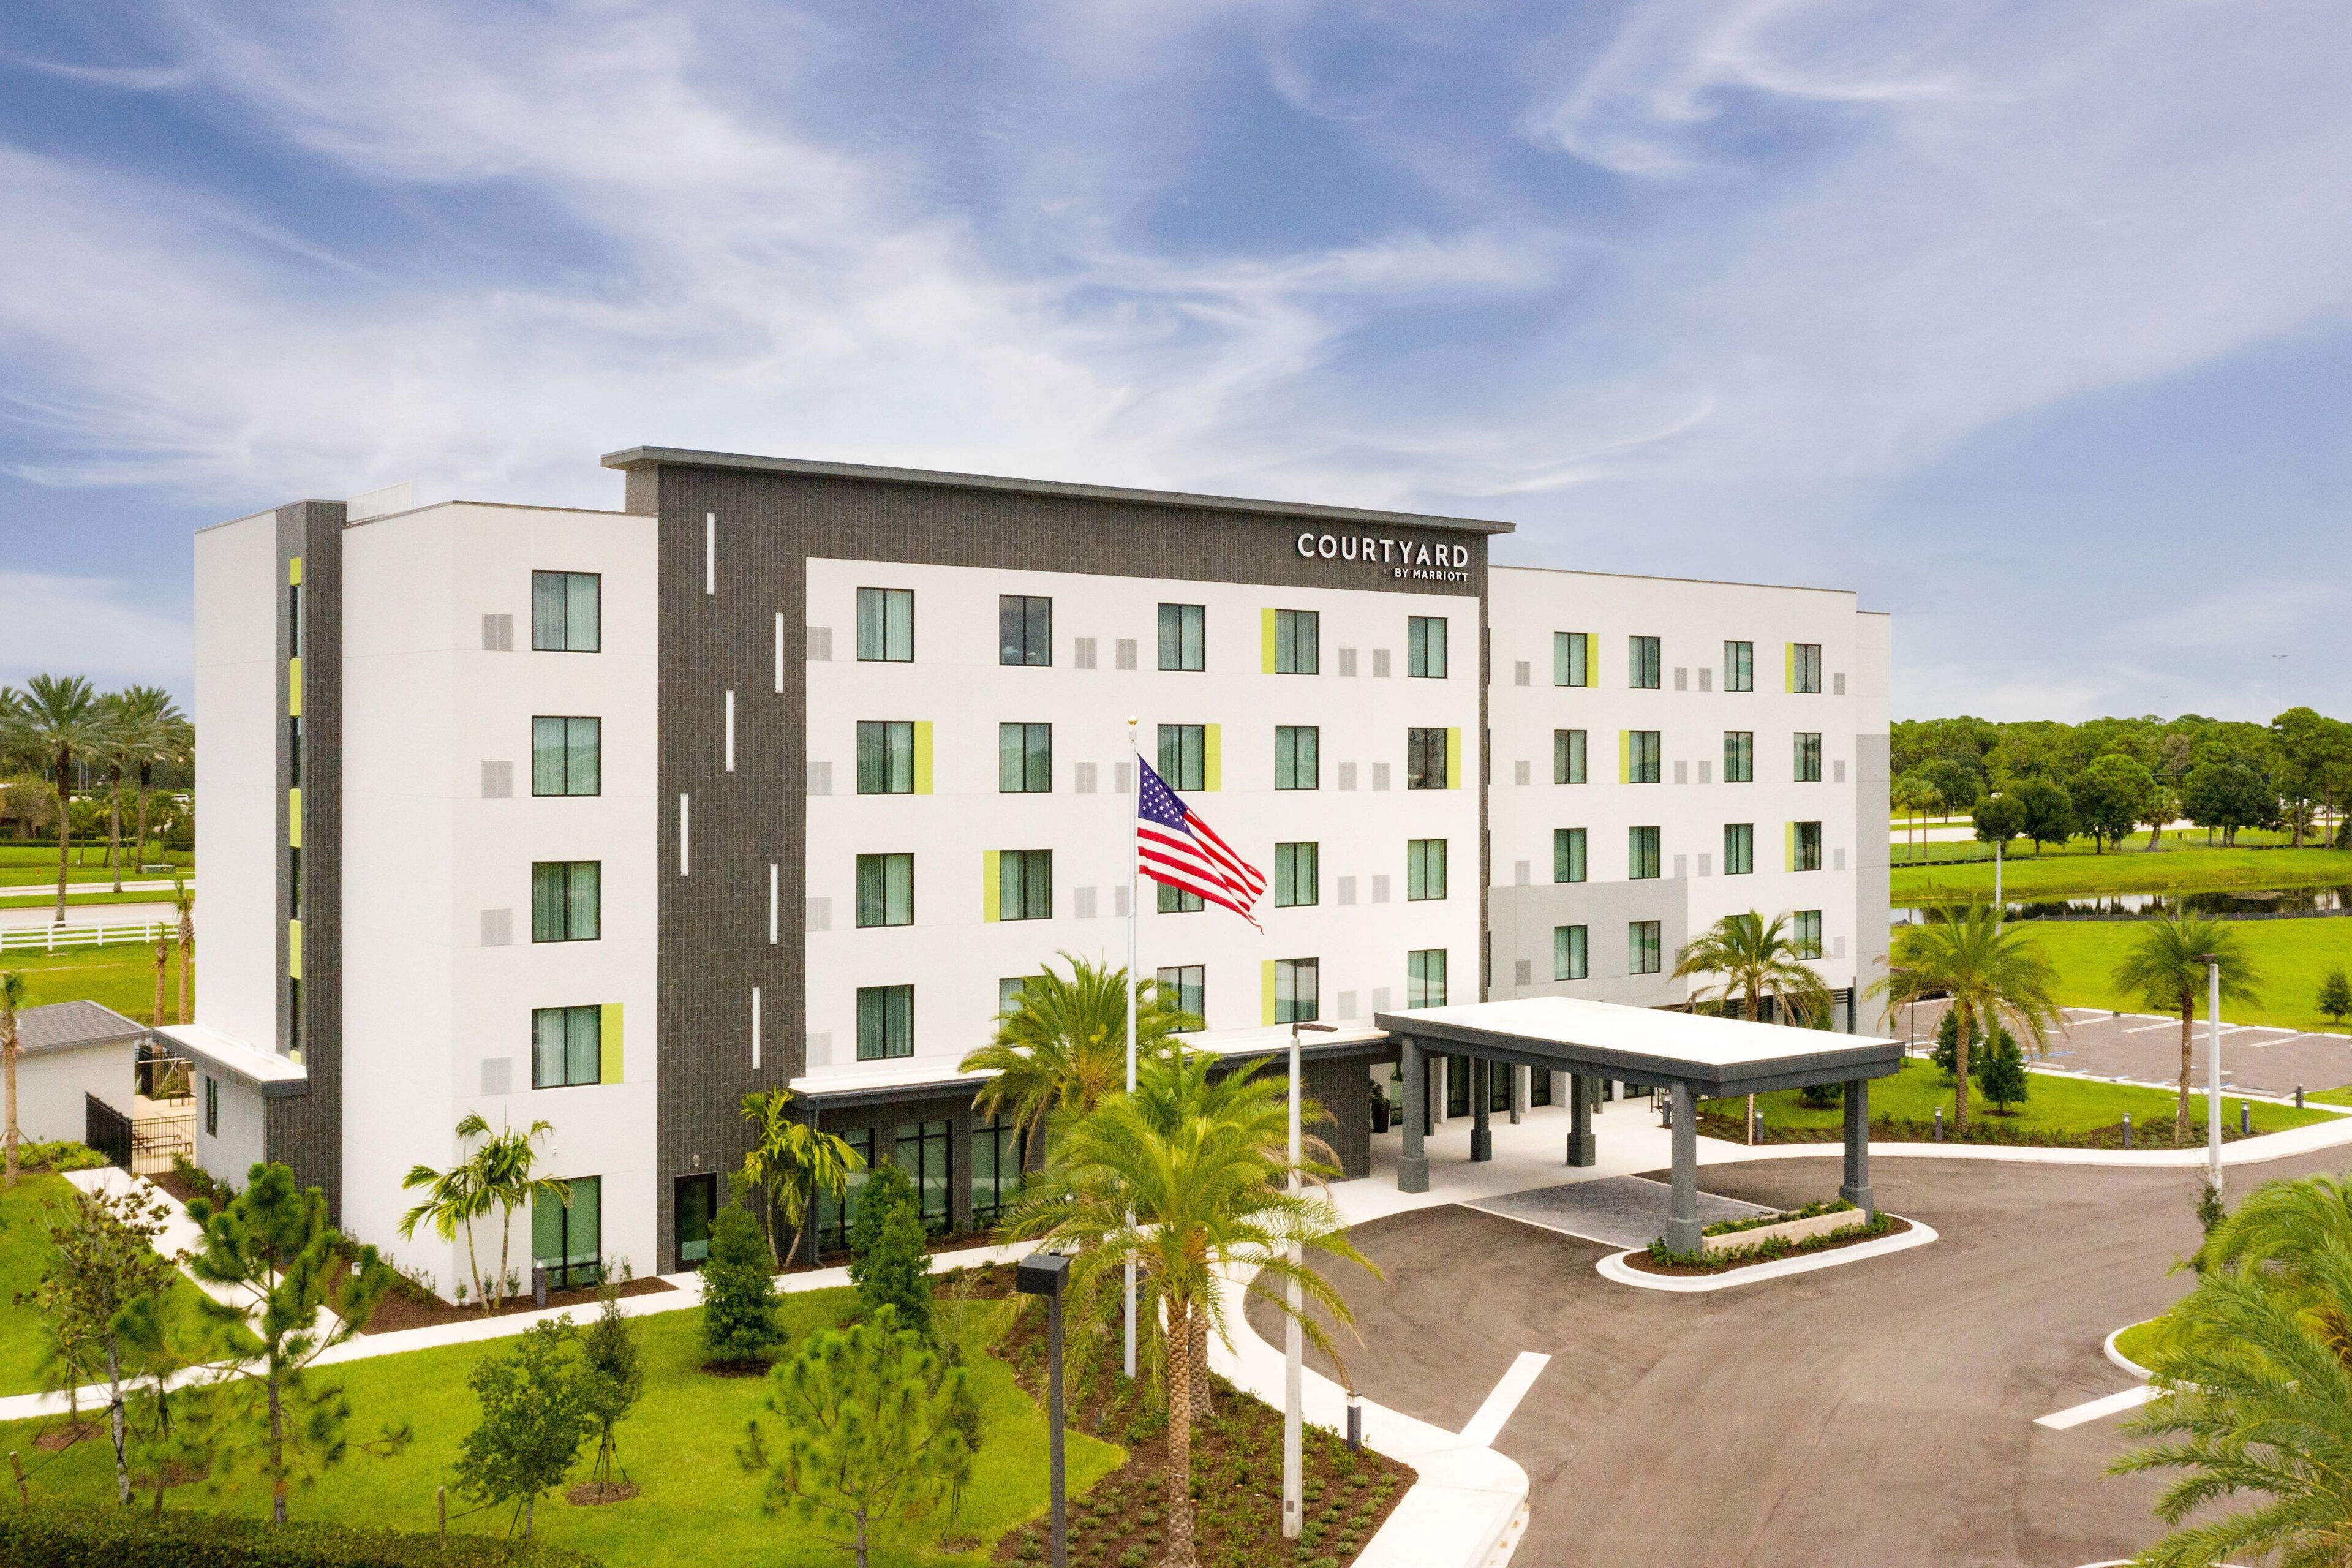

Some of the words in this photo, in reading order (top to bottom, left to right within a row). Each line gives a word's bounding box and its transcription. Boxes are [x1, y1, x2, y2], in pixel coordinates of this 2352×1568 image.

[1297, 533, 1468, 568] COURTYARD
[1395, 567, 1409, 578] BY
[1412, 569, 1468, 582] MARRIOTT
